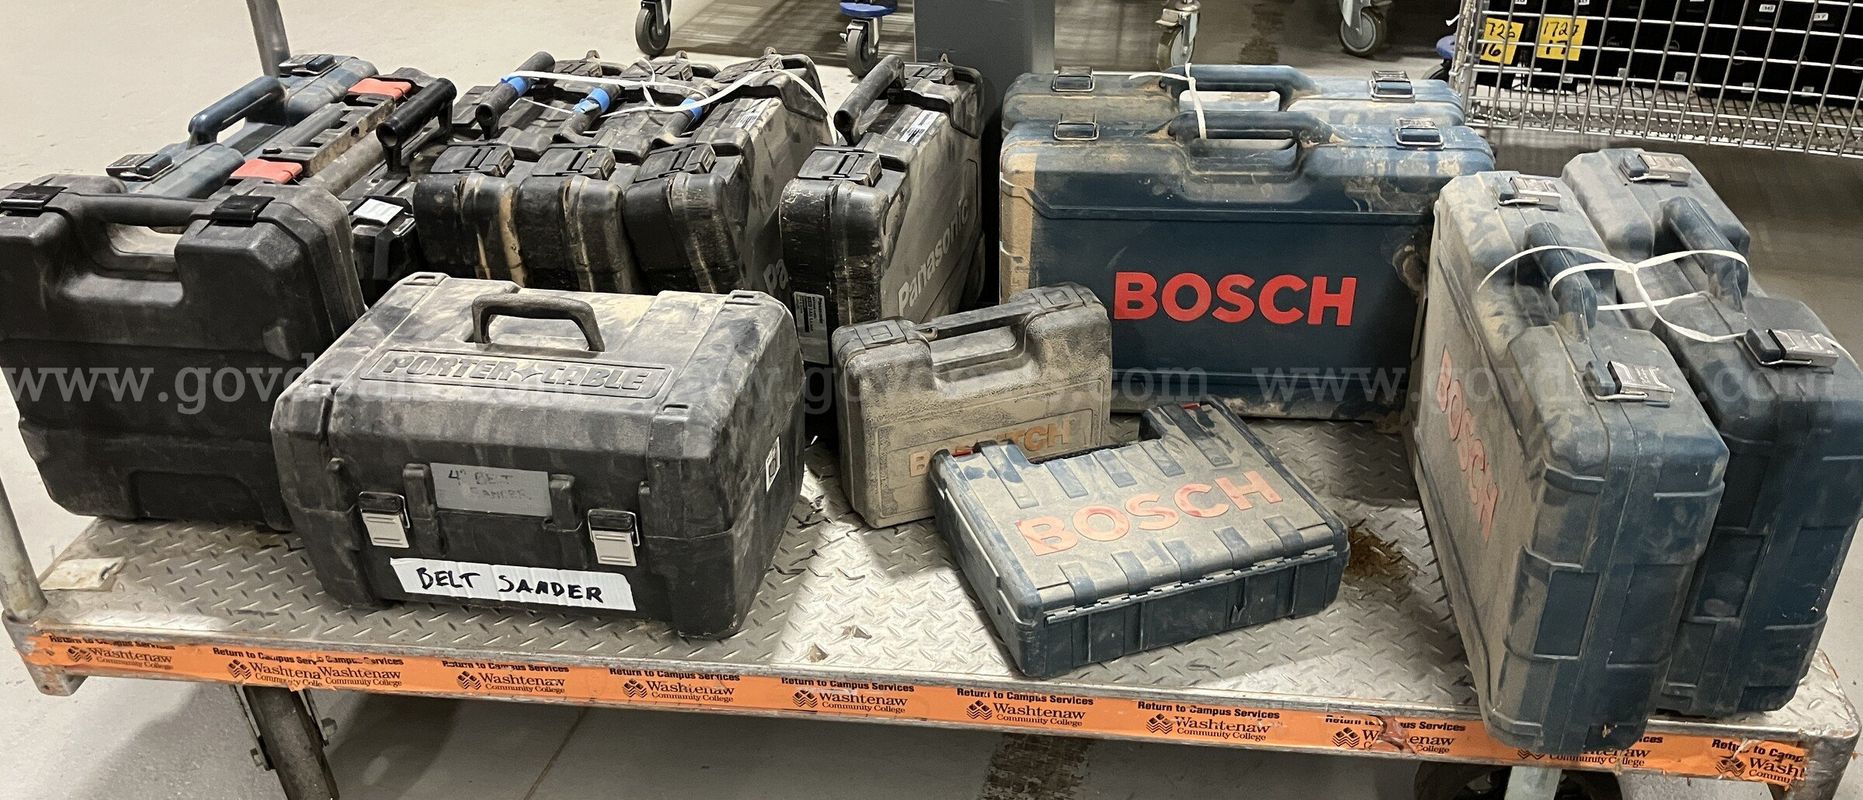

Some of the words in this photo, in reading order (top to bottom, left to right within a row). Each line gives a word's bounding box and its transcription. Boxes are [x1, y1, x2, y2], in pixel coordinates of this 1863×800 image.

[898, 200, 969, 314] Panasonic
[1113, 271, 1358, 326] BOSCH
[1436, 344, 1499, 544] BOSCH
[1015, 470, 1284, 556] BOSCH
[416, 567, 480, 590] BELT
[497, 574, 604, 603] SANDER
[89, 647, 172, 663] Washtenaw
[213, 647, 245, 658] Return
[248, 651, 256, 659] to
[318, 666, 400, 679] Washtenaw
[528, 664, 570, 672] Services
[609, 668, 642, 676] Return
[656, 670, 696, 680] Campus
[698, 672, 741, 681] Services
[325, 677, 372, 687] Community
[372, 678, 402, 687] College
[478, 672, 565, 687] Washtenaw
[781, 677, 814, 686] Return
[816, 679, 828, 687] to
[830, 680, 869, 690] Campus
[871, 682, 915, 692] Services
[485, 683, 534, 693] Community
[534, 685, 566, 694] College
[646, 680, 735, 695] Washtenaw
[651, 692, 702, 701] Community
[702, 695, 734, 703] College
[819, 692, 908, 706] Washtenaw
[956, 688, 990, 698] Return
[993, 691, 1004, 699] to
[1006, 692, 1047, 702] Campus
[1049, 695, 1094, 705] Services
[822, 702, 873, 712] Community
[873, 705, 906, 714] College
[993, 702, 1087, 719] Washtenaw
[1138, 701, 1172, 711] Return
[1175, 704, 1186, 712] to
[1189, 705, 1231, 716] Campus
[1234, 708, 1280, 719] Services
[996, 714, 1049, 725] Community
[1050, 718, 1083, 727] College
[1174, 715, 1271, 733] Washtenaw
[1419, 721, 1467, 731] Services
[1177, 727, 1231, 739] Community
[1232, 731, 1267, 742] College
[1417, 744, 1450, 754] College
[1753, 745, 1766, 755] to
[1607, 756, 1645, 768] Cllege
